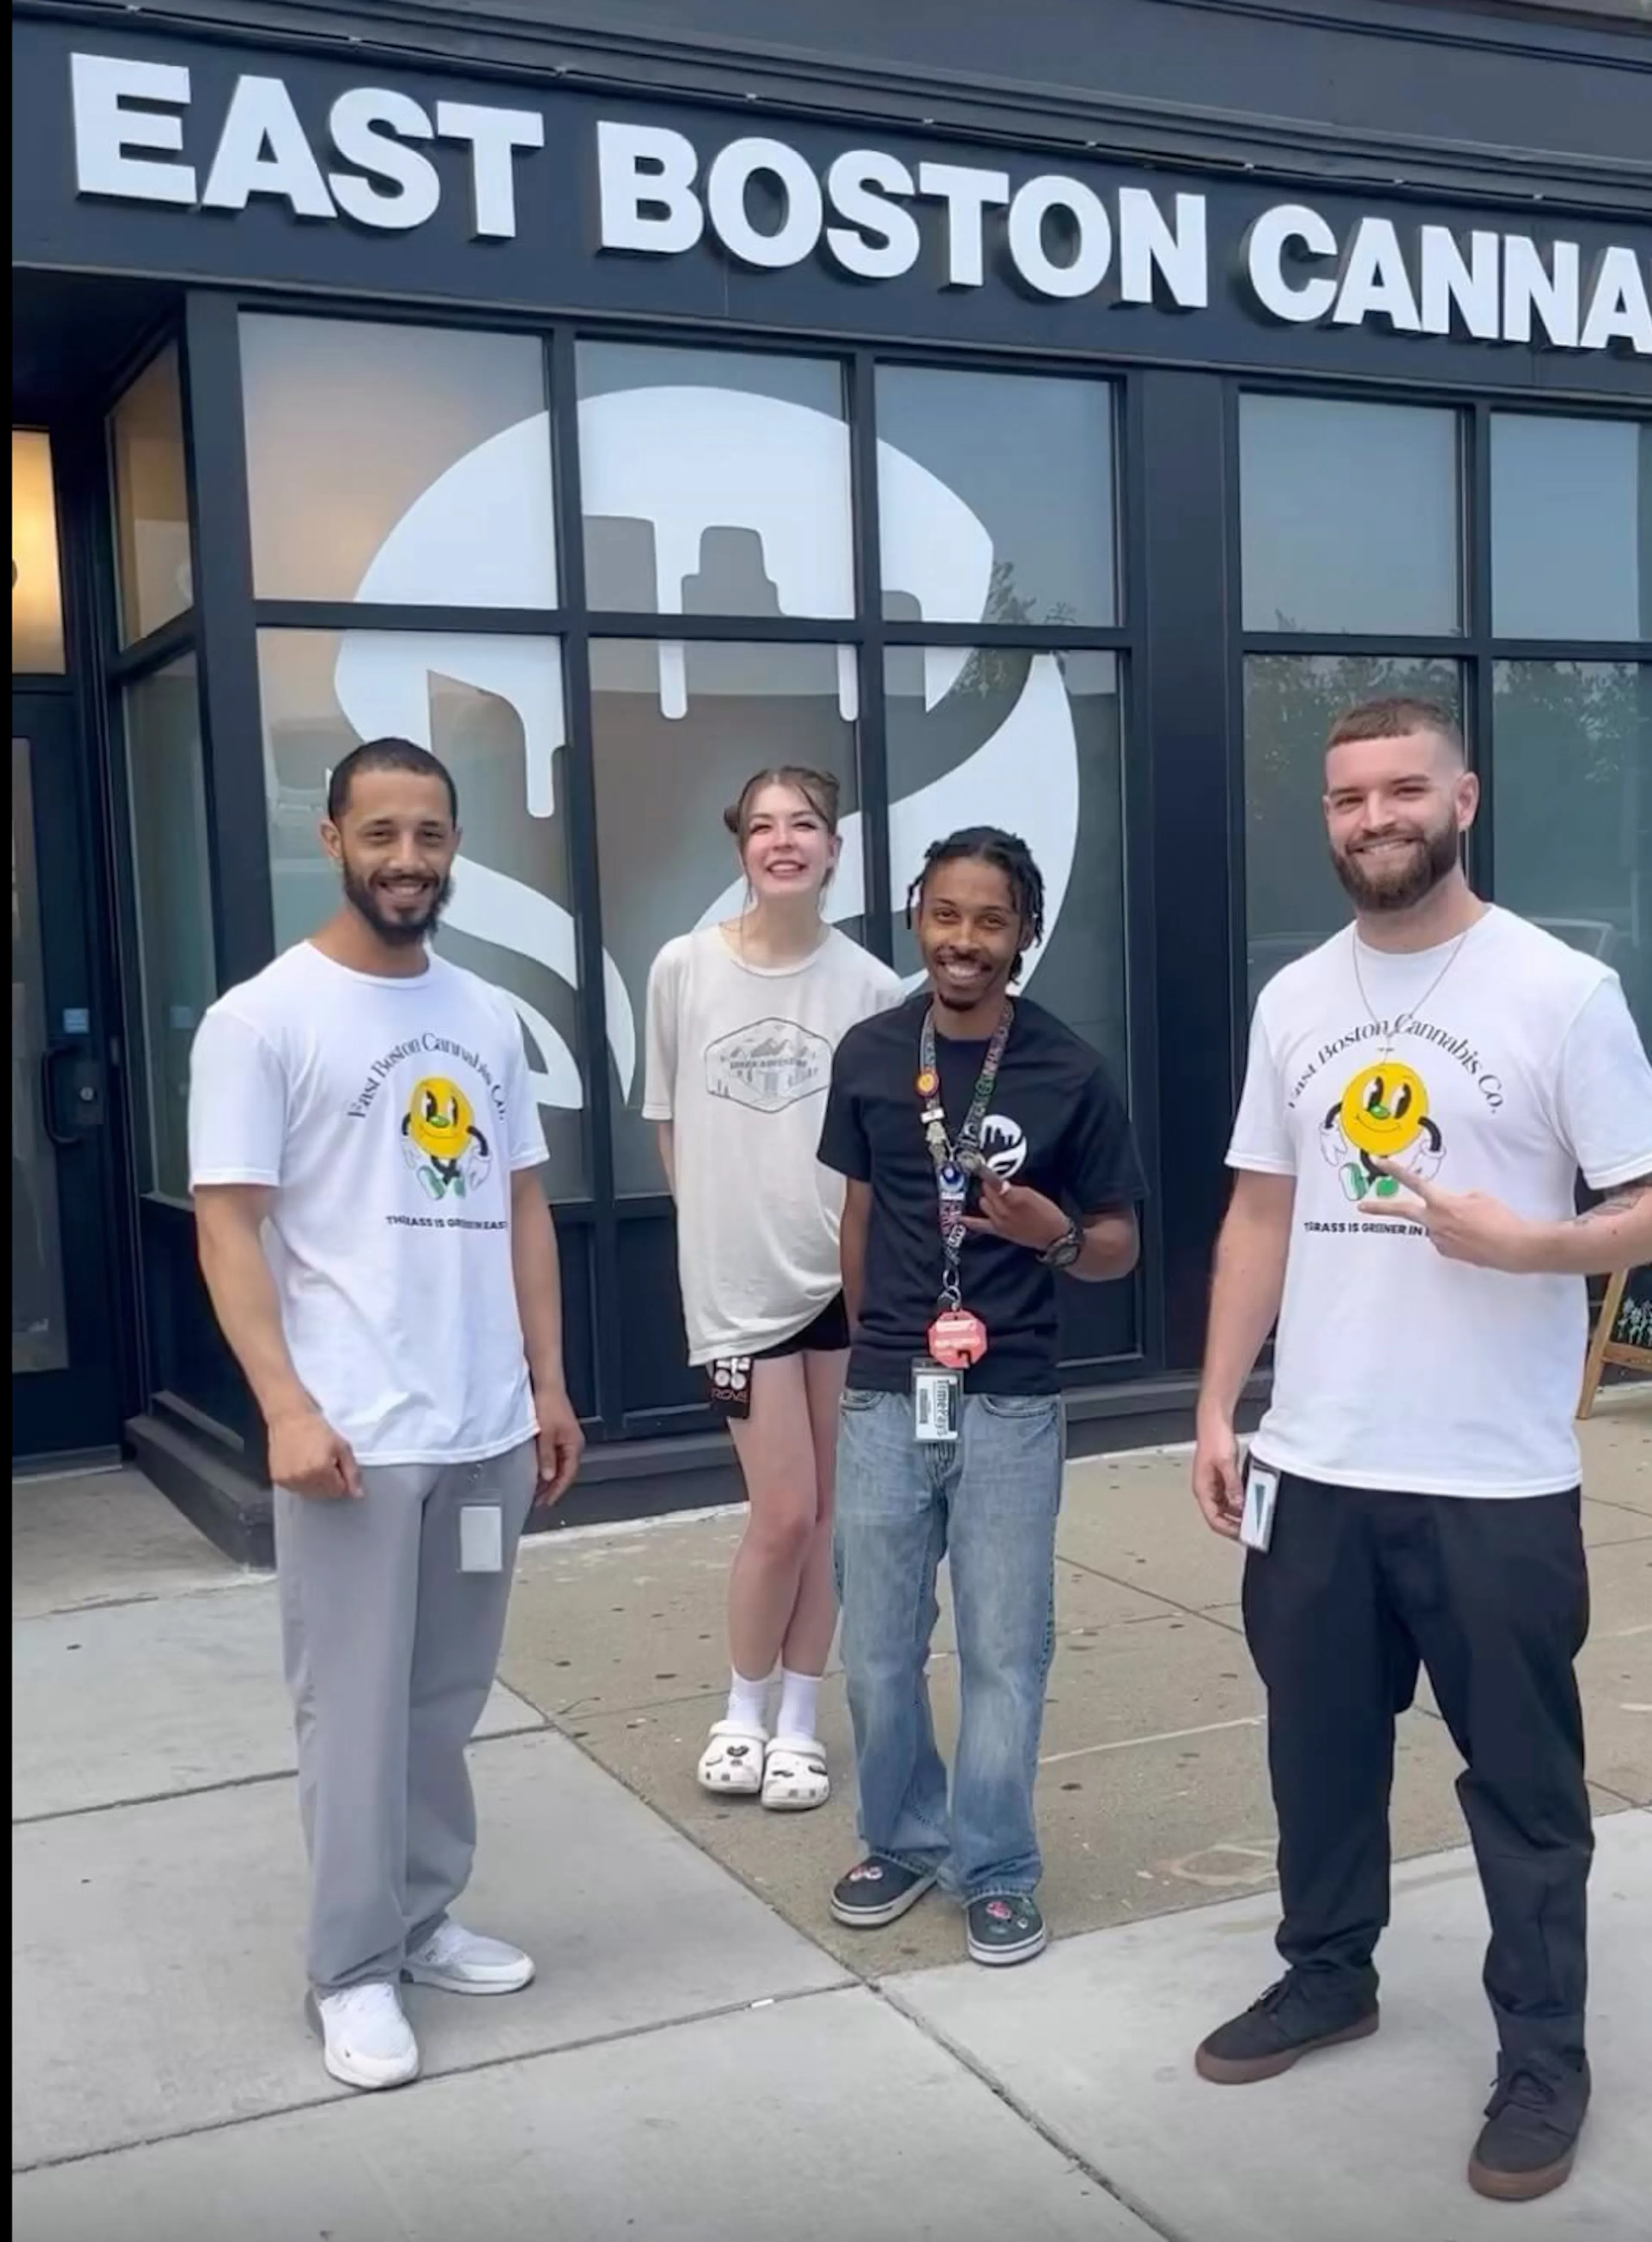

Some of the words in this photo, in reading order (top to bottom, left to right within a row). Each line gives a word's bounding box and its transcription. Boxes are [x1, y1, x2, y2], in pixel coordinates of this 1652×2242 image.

[70, 52, 544, 239] EAST
[596, 120, 1208, 308] BOSTON
[1247, 204, 1652, 354] CANNA
[347, 1076, 380, 1118] East
[1318, 1020, 1389, 1065] Boston
[1394, 1013, 1482, 1075] Cannabis
[1477, 1074, 1504, 1114] Co.
[1348, 1222, 1359, 1233] IS
[1408, 1224, 1423, 1236] IN
